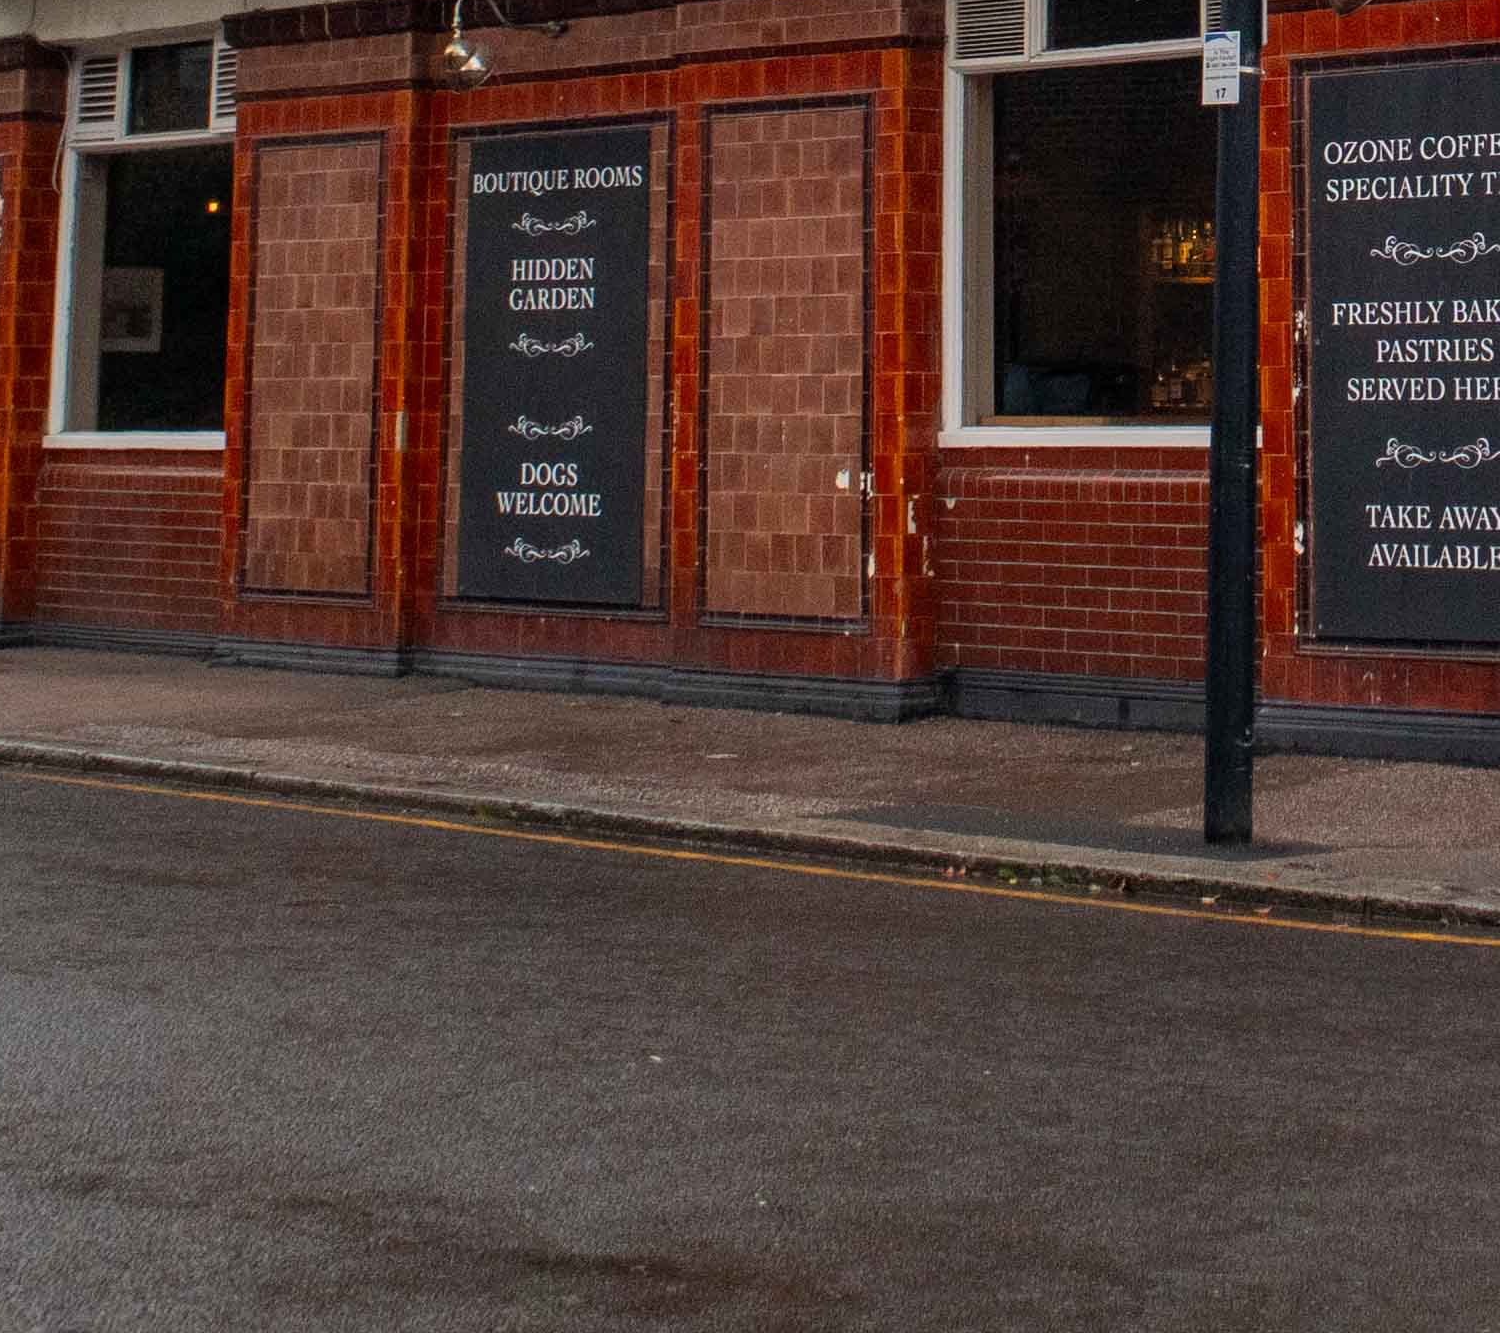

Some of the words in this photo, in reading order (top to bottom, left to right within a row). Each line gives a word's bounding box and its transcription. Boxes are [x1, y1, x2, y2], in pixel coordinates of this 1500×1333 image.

[1215, 87, 1228, 101] 17
[1323, 137, 1413, 165] OZONE
[473, 169, 569, 197] BOUTIQUE
[573, 165, 643, 189] ROOMS
[1325, 172, 1475, 203] SPECIALITY
[511, 257, 595, 282] HIDDEN
[508, 286, 595, 311] GARDEN
[1331, 300, 1445, 326] FRESHLY
[1376, 337, 1495, 363] PASTRIES
[1347, 377, 1446, 402] SERVED
[520, 462, 578, 487] DOGS
[496, 491, 602, 517] WELCOME
[1365, 504, 1432, 530] TAKE
